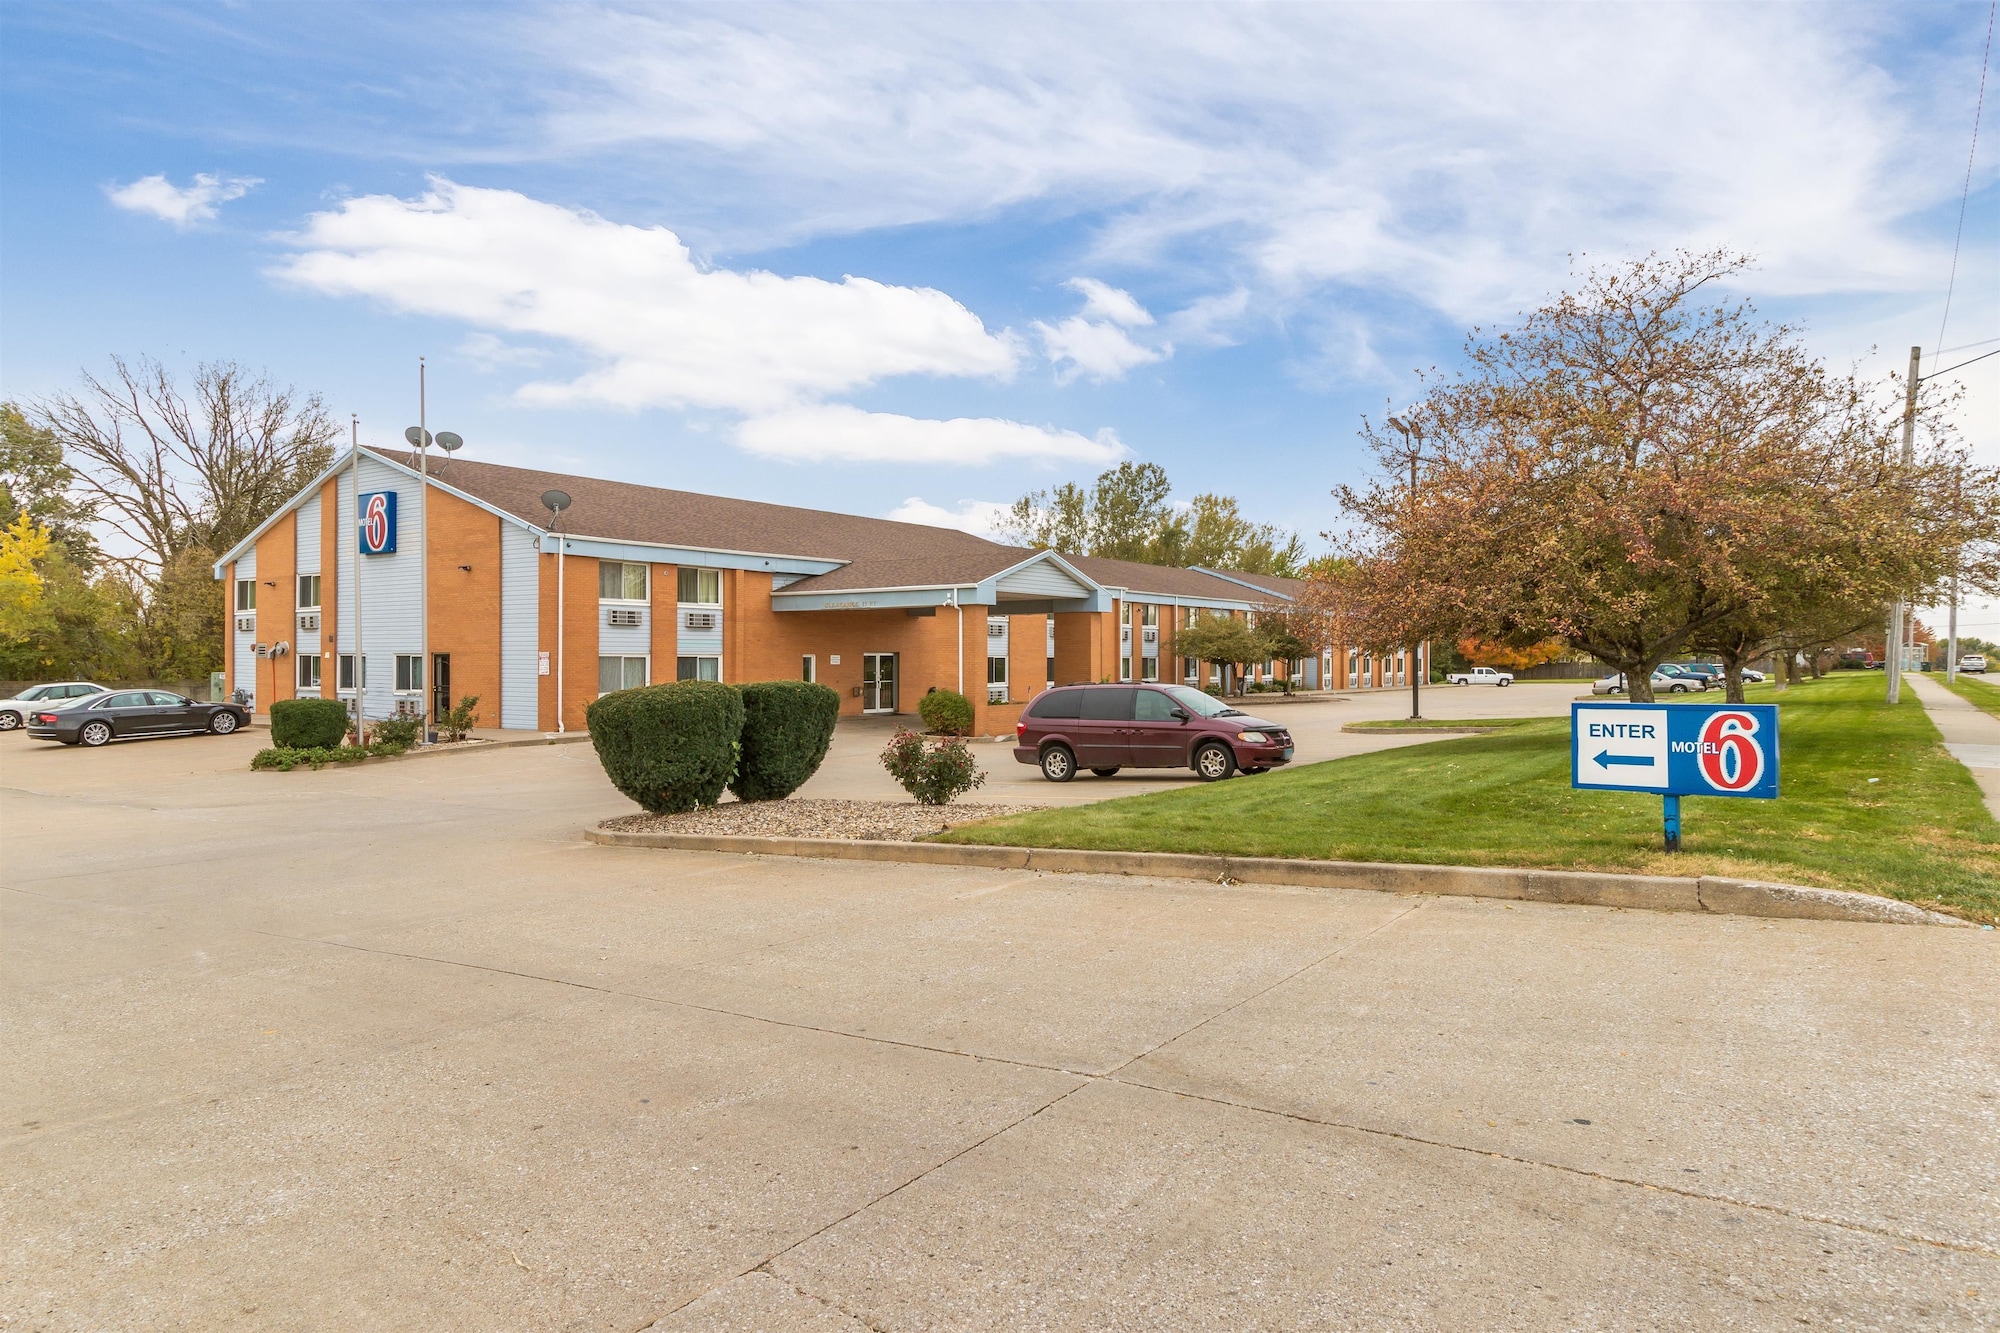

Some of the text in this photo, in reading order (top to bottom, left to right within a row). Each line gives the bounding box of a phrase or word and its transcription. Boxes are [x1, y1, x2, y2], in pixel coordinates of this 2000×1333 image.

[358, 494, 388, 551] MOTEL 6
[1589, 723, 1656, 739] ENTER
[1671, 711, 1764, 792] MOTEL 6
